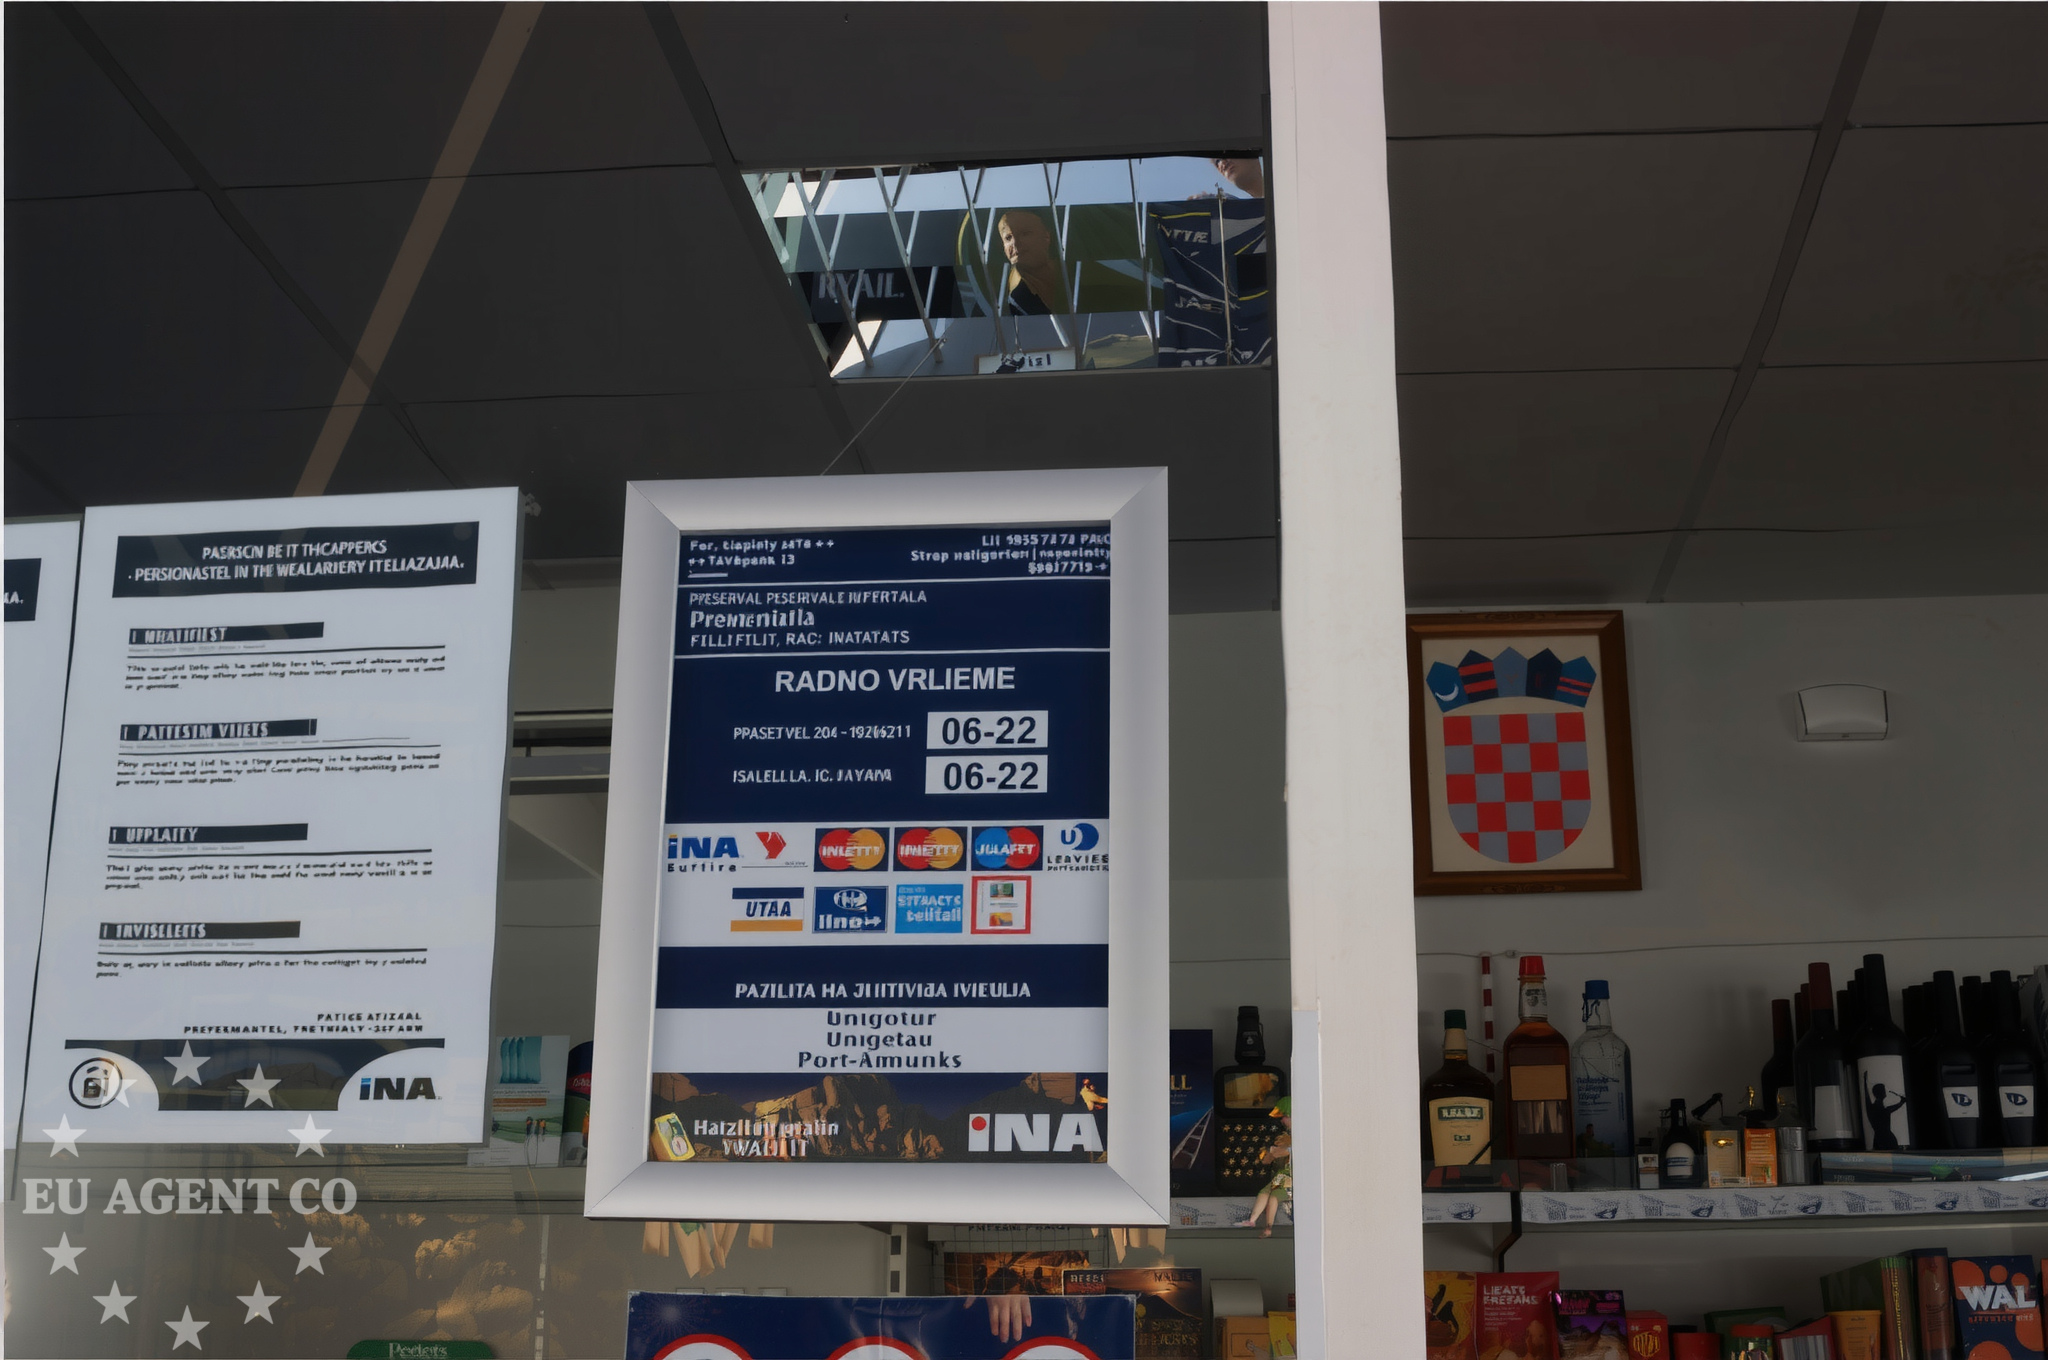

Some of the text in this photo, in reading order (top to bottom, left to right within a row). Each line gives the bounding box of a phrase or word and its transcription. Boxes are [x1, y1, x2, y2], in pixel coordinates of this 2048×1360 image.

[775, 668, 881, 693] RADNO
[942, 716, 1037, 746] 06-22
[944, 761, 1039, 792] 06-22
[1957, 1284, 2036, 1311] WAL
